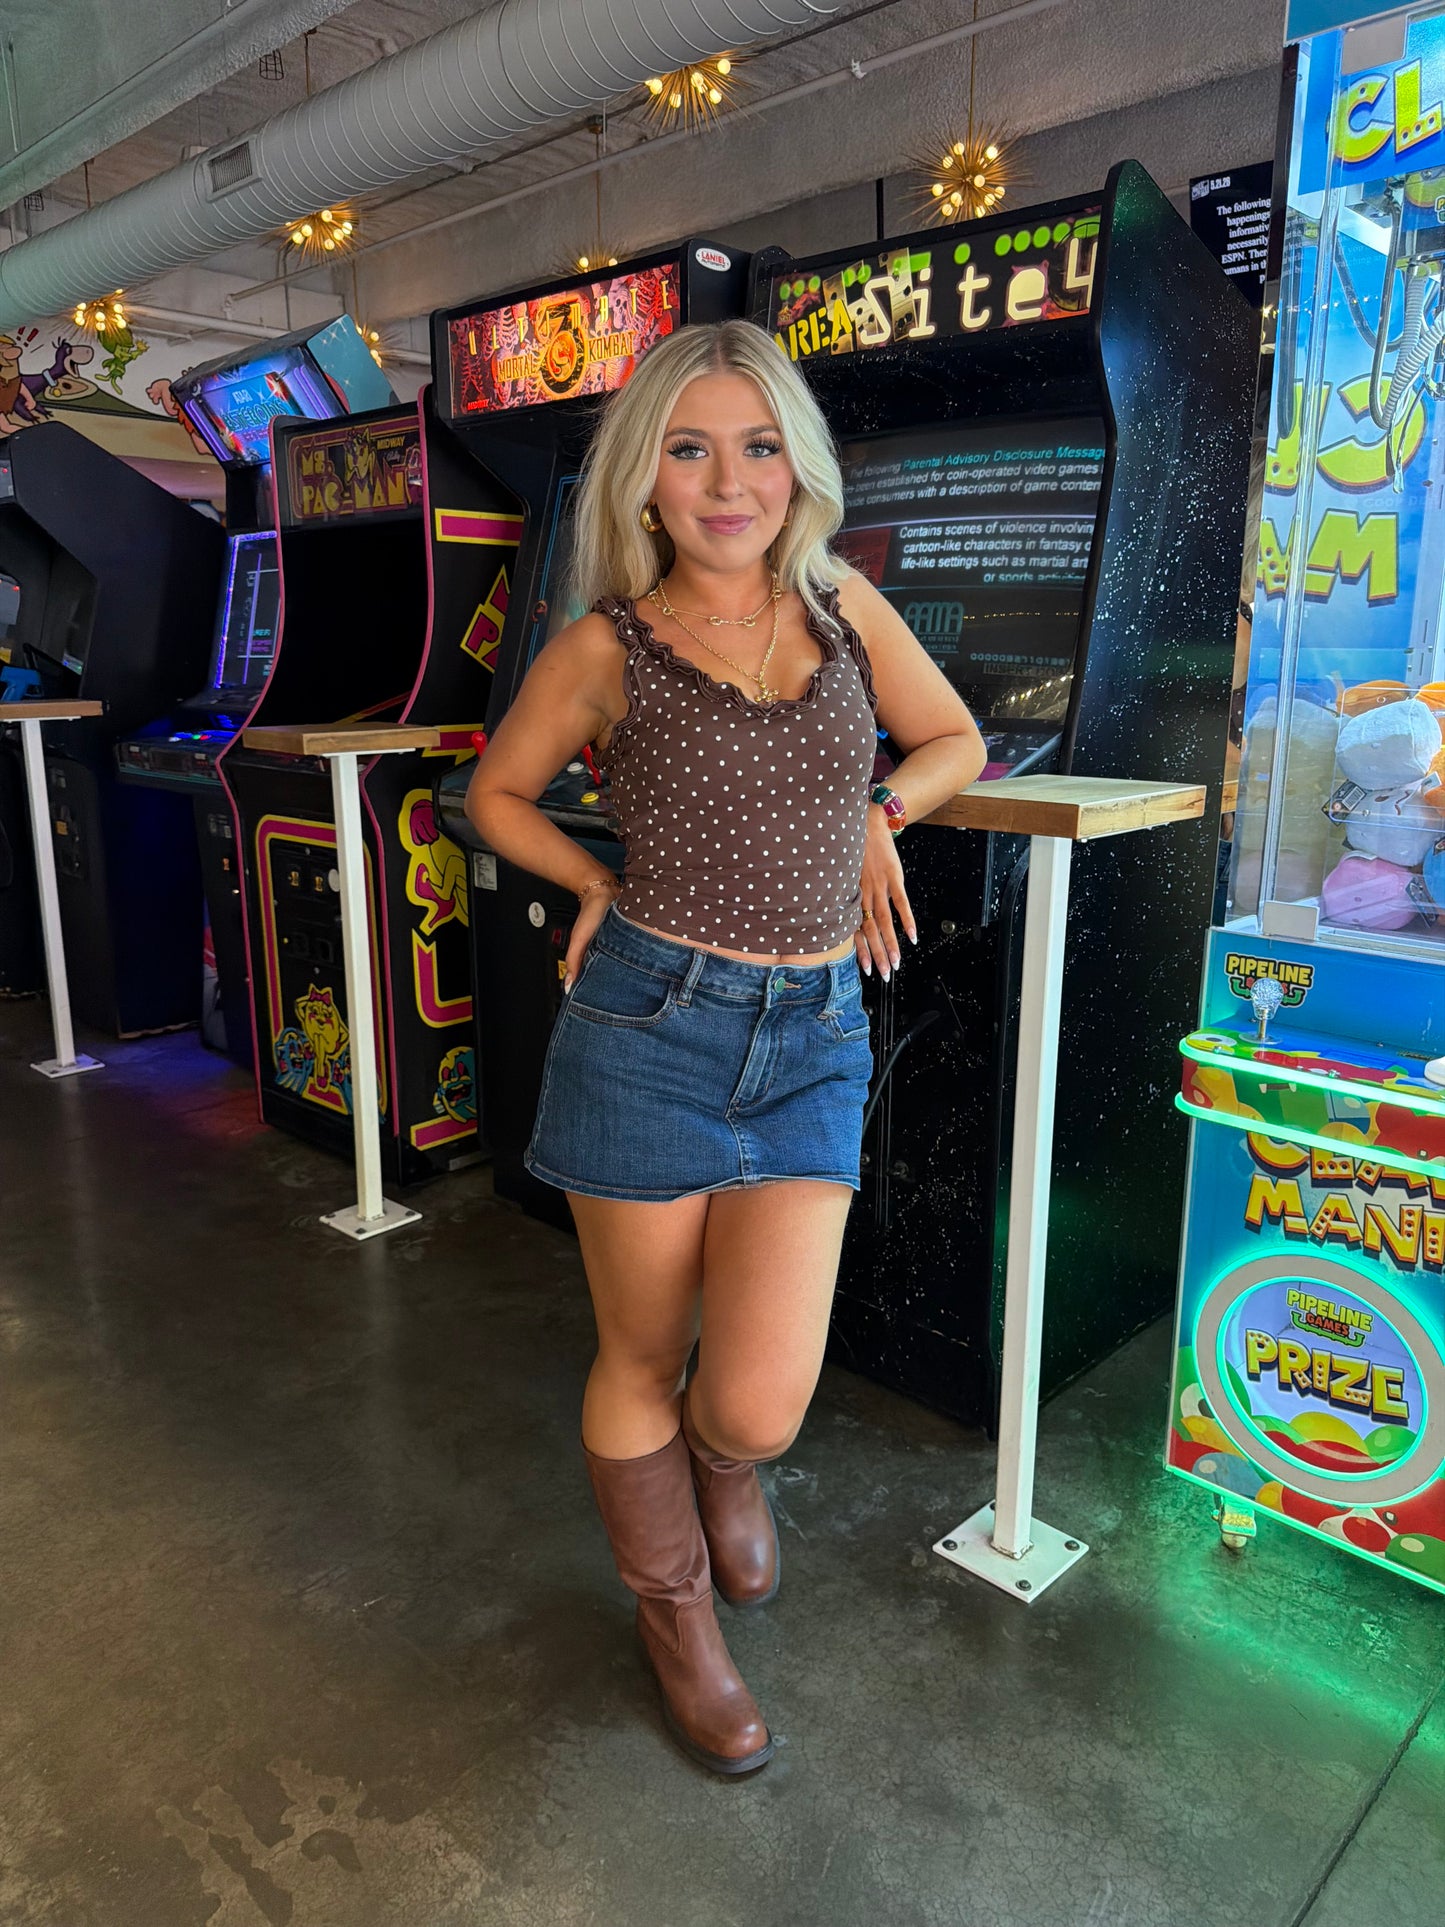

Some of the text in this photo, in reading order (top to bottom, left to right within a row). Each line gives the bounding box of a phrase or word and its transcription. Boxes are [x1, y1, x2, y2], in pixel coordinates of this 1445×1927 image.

[1326, 57, 1445, 163] CL
[1216, 197, 1271, 216] The following
[1226, 210, 1271, 227] happenings
[1228, 223, 1270, 238] informativ
[1226, 235, 1268, 251] necessarily
[701, 250, 726, 265] LANIEL
[1221, 248, 1268, 264] ESPN. Ther
[1224, 264, 1249, 276] umans
[1250, 261, 1260, 271] in
[497, 352, 538, 383] MORTAL
[587, 330, 637, 363] KOMBAT
[377, 436, 405, 450] MIDWAY
[863, 461, 901, 478] following
[903, 458, 944, 471] Parental
[945, 452, 990, 467] Advisory
[993, 448, 1053, 462] Disclosure
[876, 470, 928, 488] established
[930, 467, 945, 482] for
[946, 464, 1021, 482] coin-operated
[1023, 463, 1056, 476] video
[1057, 464, 1099, 478] games
[866, 489, 915, 505] consumers
[916, 484, 937, 498] with
[938, 487, 947, 497] a
[948, 482, 1007, 497] description
[1009, 480, 1024, 492] of
[1024, 482, 1058, 495] game
[1060, 479, 1102, 491] conten
[899, 520, 1095, 539] Contains scenes of violence involvin
[903, 539, 962, 554] cartoon-like
[963, 538, 1024, 551] characters
[1026, 537, 1037, 550] in
[1038, 537, 1083, 552] fantasy
[901, 554, 1089, 570] life-like settings such as martial art
[984, 573, 995, 583] or
[1227, 955, 1313, 986] PIPELINE
[1244, 1172, 1445, 1267] MANI
[1287, 1288, 1373, 1332] PIPELINE
[1305, 1312, 1350, 1336] GAMES
[1246, 1328, 1410, 1422] PRIZE
